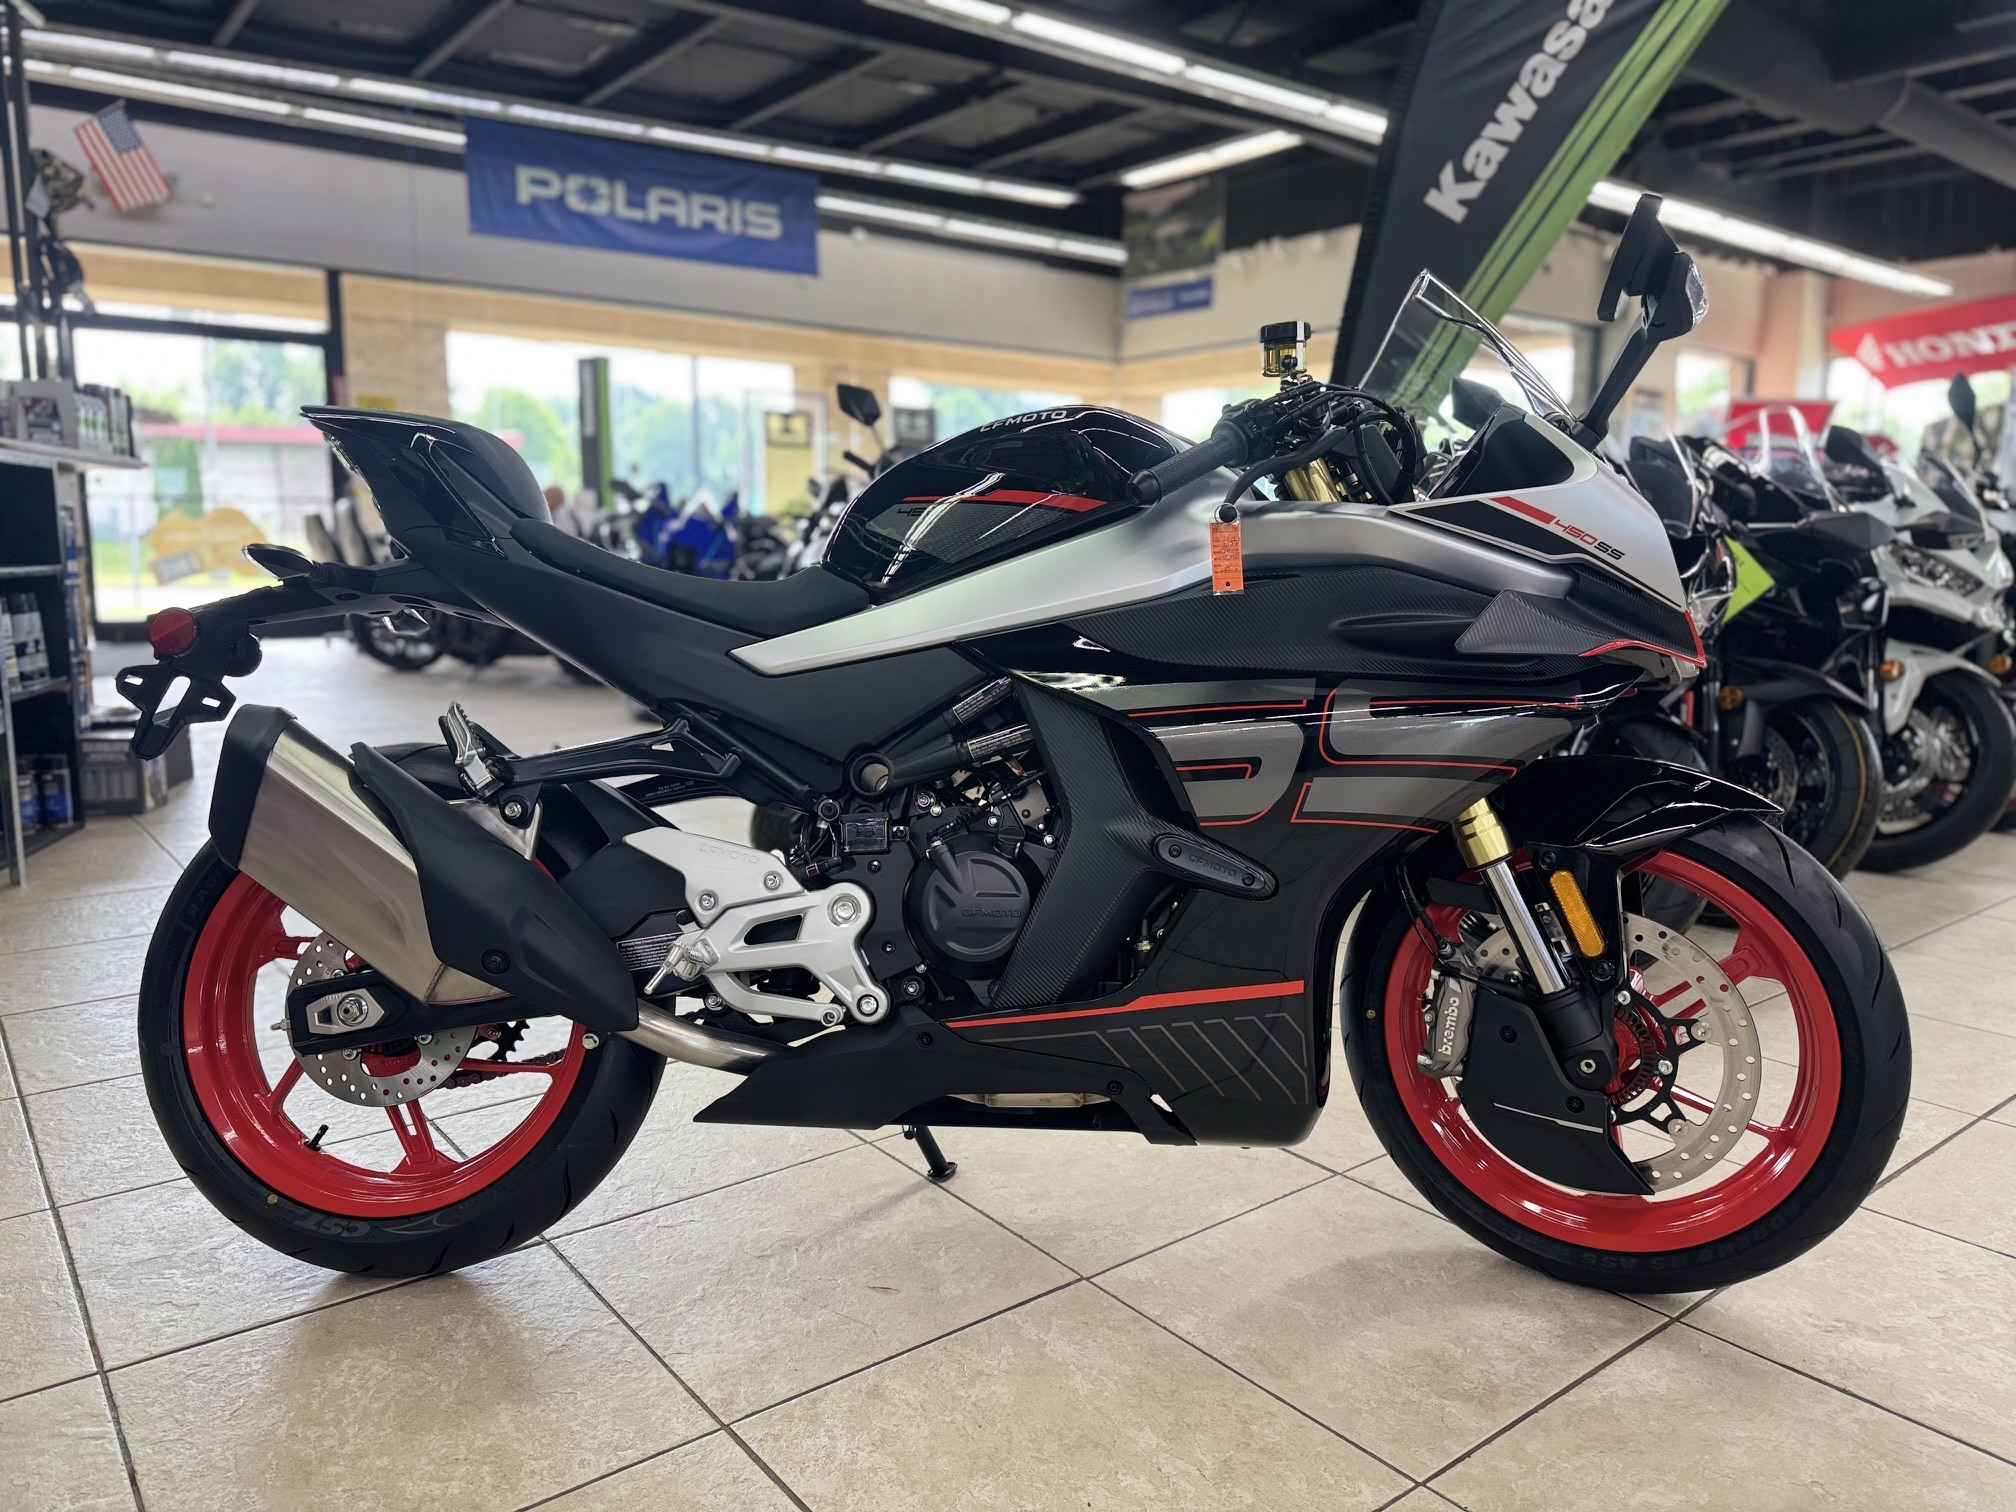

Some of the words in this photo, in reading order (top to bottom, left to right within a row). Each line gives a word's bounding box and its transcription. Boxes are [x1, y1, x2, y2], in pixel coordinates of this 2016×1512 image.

[514, 165, 783, 241] POLARIS
[978, 410, 1068, 433] CFMOTO
[1553, 519, 1626, 560] 450SS
[697, 843, 760, 865] CFMOTO
[1188, 853, 1237, 878] CFMOTO
[961, 907, 1022, 918] CFMOTO
[1437, 996, 1460, 1056] brembo
[292, 1214, 371, 1241] CST
